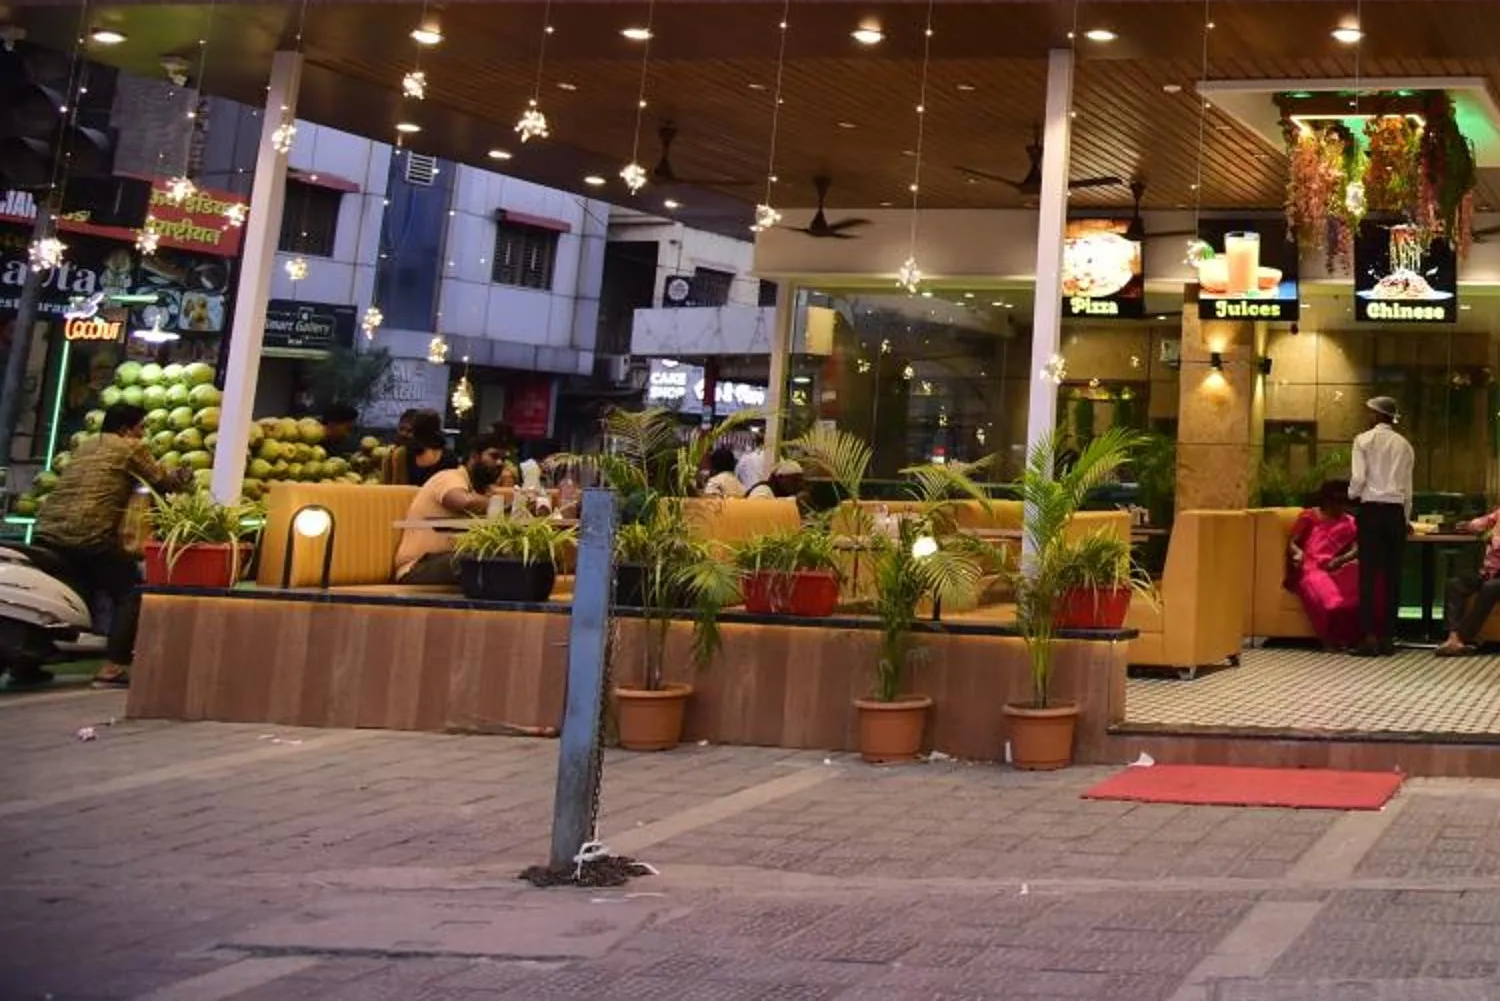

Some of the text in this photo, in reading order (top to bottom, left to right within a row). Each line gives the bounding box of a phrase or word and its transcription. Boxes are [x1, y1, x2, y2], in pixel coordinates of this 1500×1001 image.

[1069, 297, 1119, 314] Pizza
[1215, 302, 1281, 318] Juices
[1366, 302, 1445, 319] Chinese
